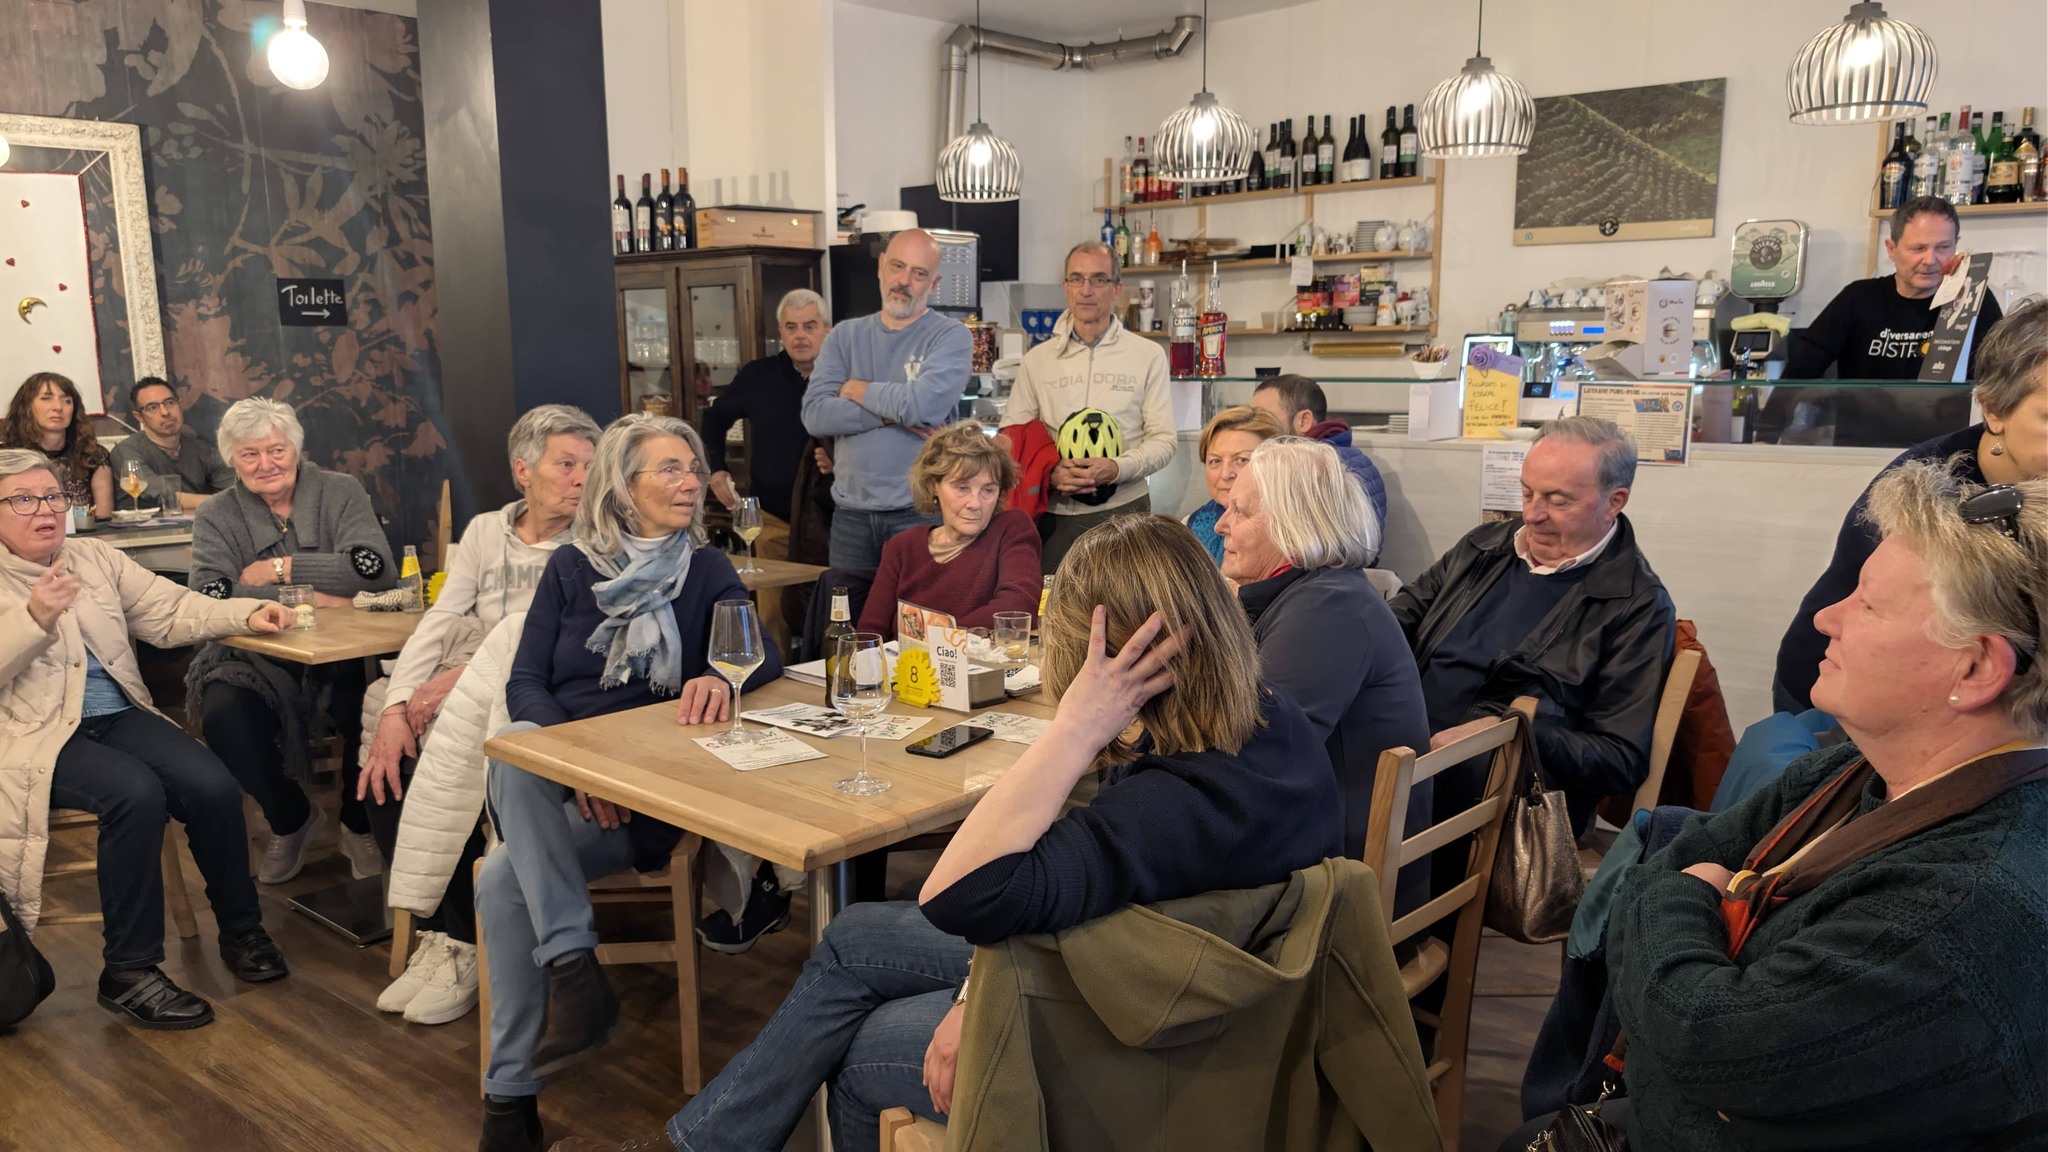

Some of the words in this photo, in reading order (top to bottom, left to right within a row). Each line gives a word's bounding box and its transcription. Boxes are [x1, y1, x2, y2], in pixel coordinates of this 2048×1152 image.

[281, 285, 344, 307] Toilette
[936, 646, 958, 659] Ciao!
[910, 665, 919, 683] 8
